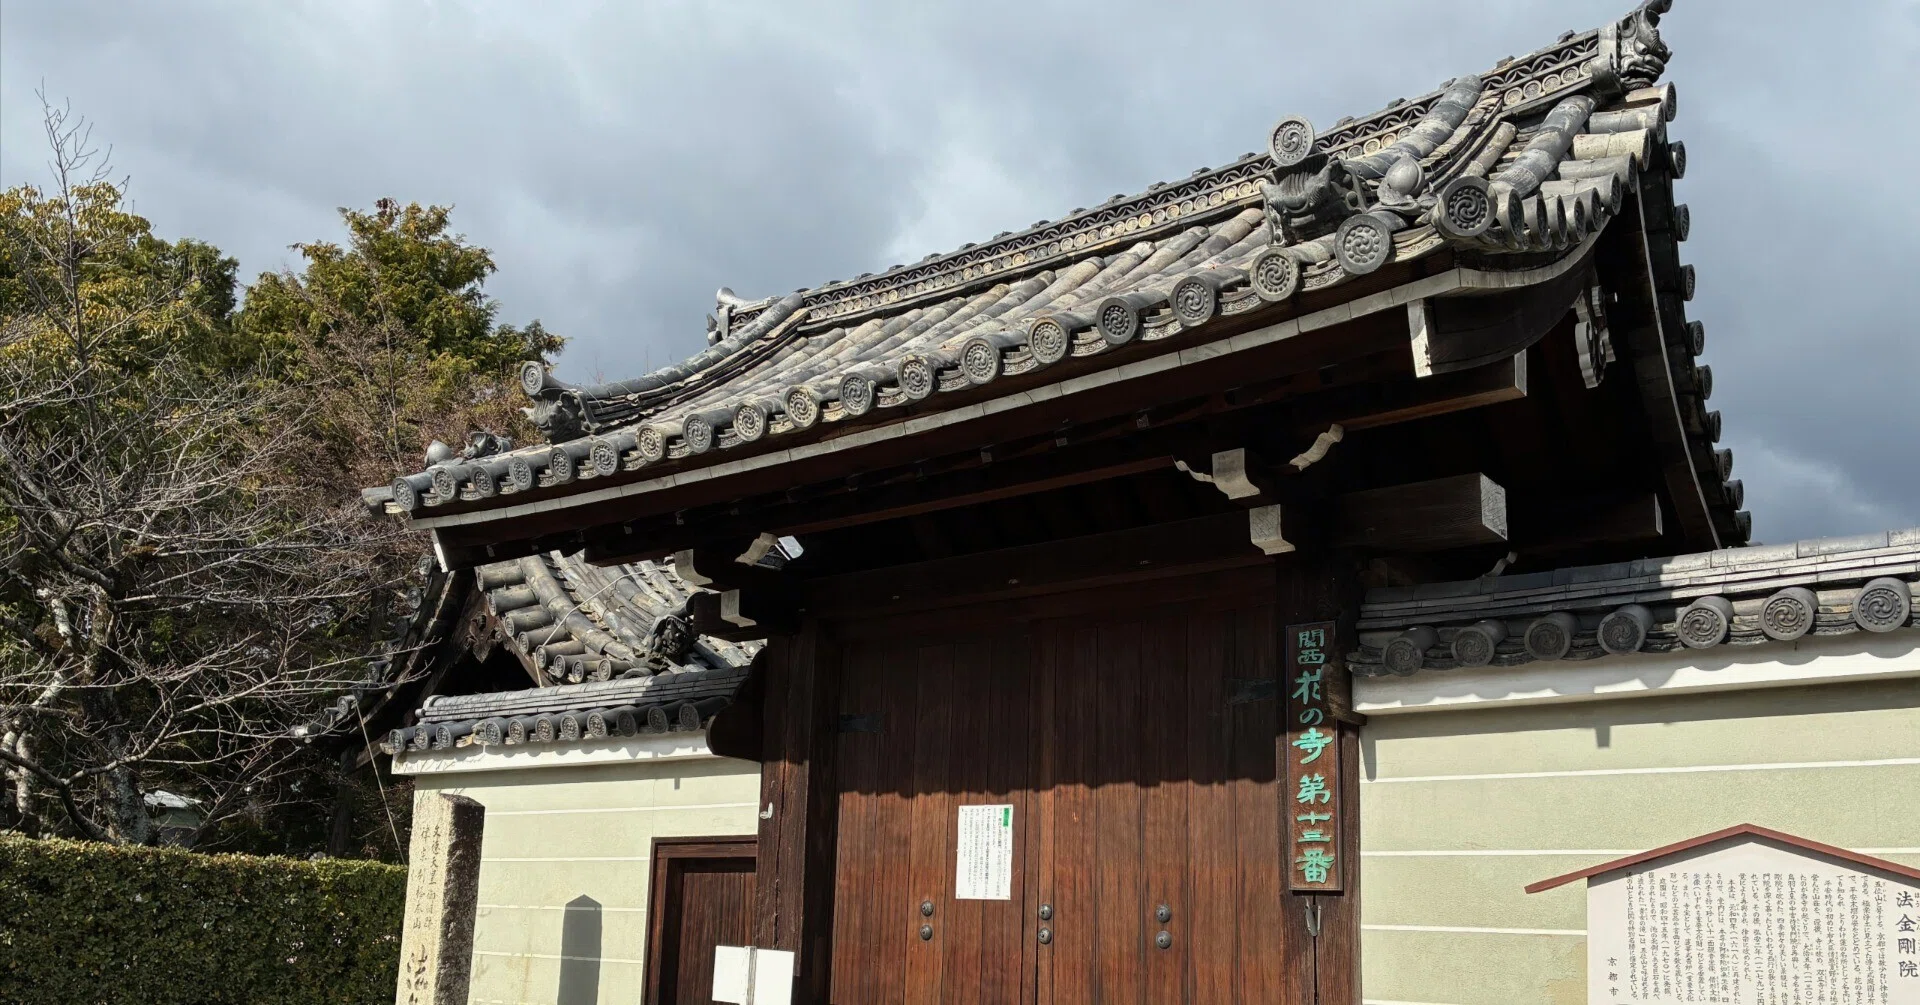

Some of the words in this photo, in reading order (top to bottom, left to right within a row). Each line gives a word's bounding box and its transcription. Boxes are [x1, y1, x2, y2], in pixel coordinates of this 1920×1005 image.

[1895, 890, 1919, 978] 法金剛院
[1608, 956, 1619, 997] 京都市
